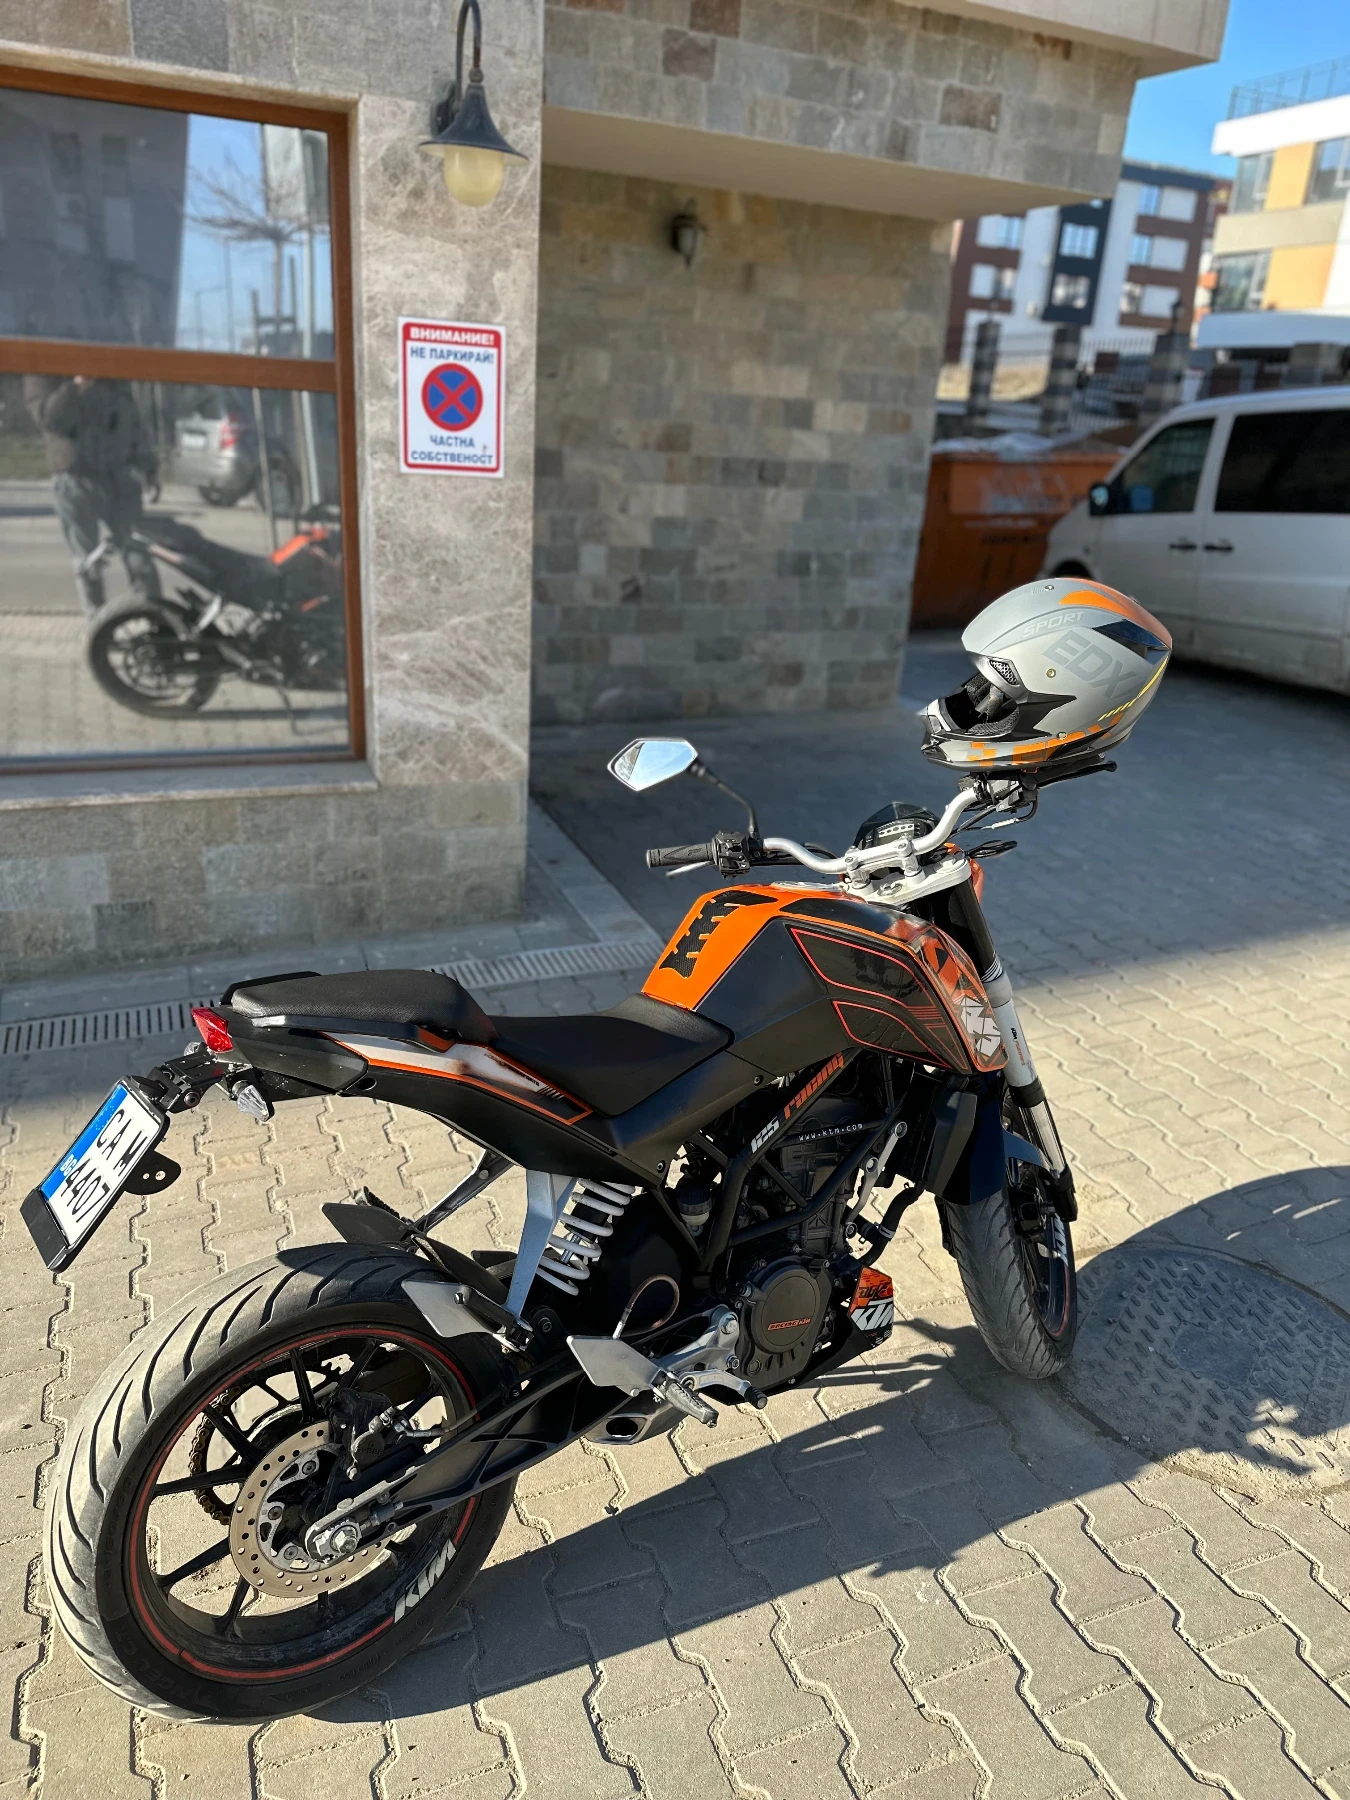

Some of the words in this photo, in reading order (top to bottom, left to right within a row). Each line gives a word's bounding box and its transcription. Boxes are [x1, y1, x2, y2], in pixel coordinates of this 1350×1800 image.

[410, 327, 495, 345] ВНИМАНИЕ!
[410, 347, 426, 358] НЕ
[429, 348, 494, 363] ПАРКИРАЙ!
[430, 435, 475, 448] ЧАСТНА
[411, 451, 493, 464] СОБСТВЕНОСТ
[1022, 611, 1084, 638] SPORT
[751, 1115, 780, 1153] 125
[783, 1052, 844, 1120] racing
[96, 1109, 132, 1160] CA
[60, 1154, 77, 1176] BG
[113, 1130, 148, 1177] M
[60, 1158, 111, 1223] 4407
[394, 1539, 456, 1624] KTM
